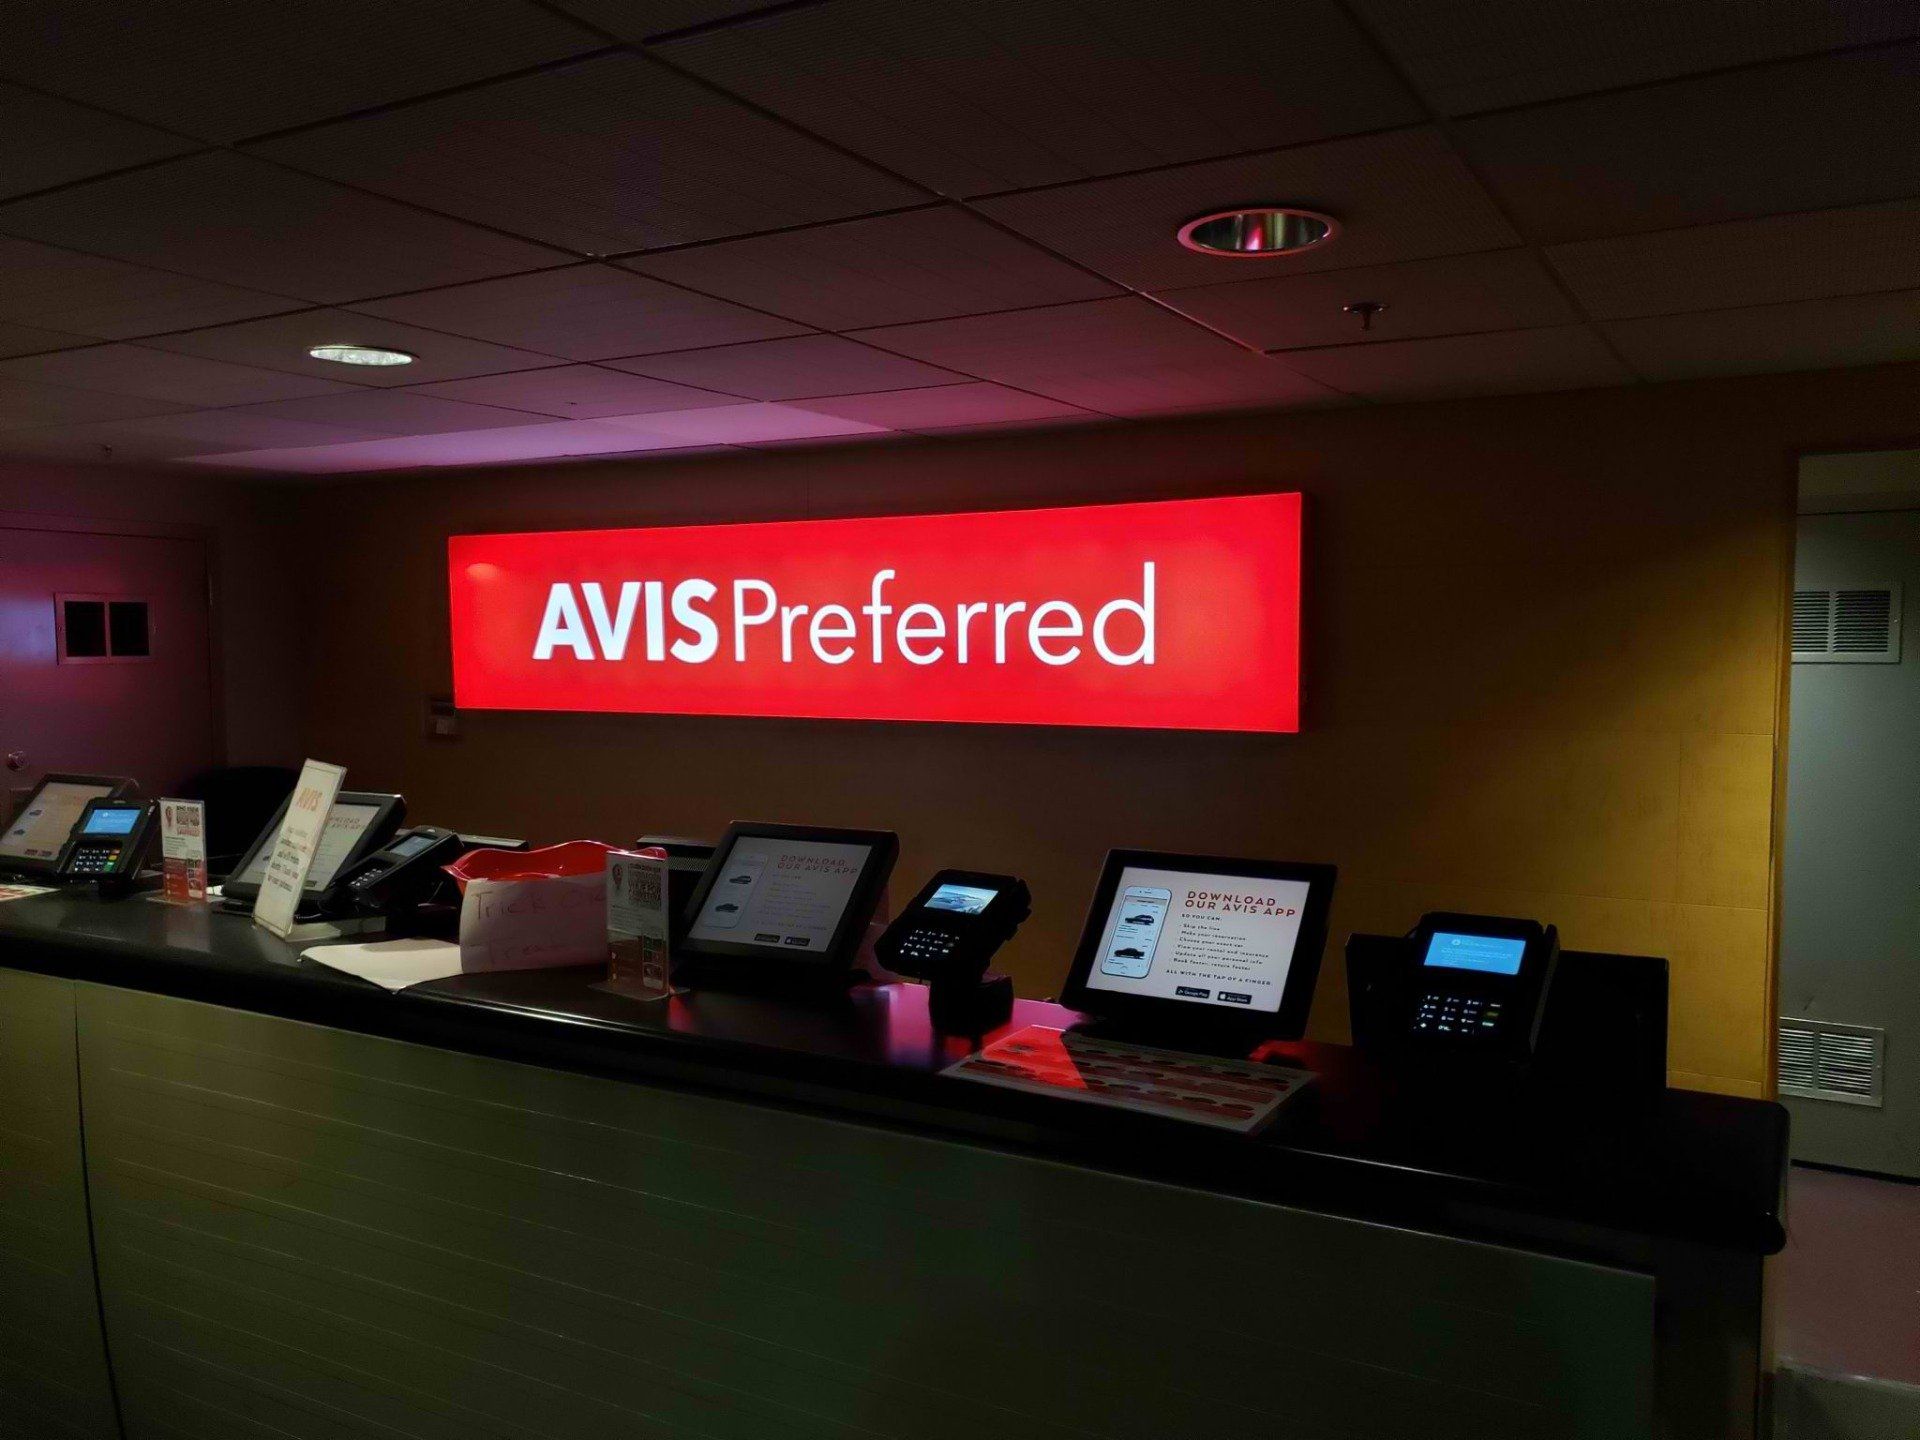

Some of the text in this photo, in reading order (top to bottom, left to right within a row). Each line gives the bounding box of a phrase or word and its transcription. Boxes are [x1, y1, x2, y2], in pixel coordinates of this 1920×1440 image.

[533, 561, 1155, 666] AVIS Preferred
[780, 854, 846, 867] DOWNLOAD
[805, 865, 830, 873] AVIS
[1187, 890, 1277, 906] DOWNLOAD
[1185, 899, 1296, 917] OUR AVIS APP
